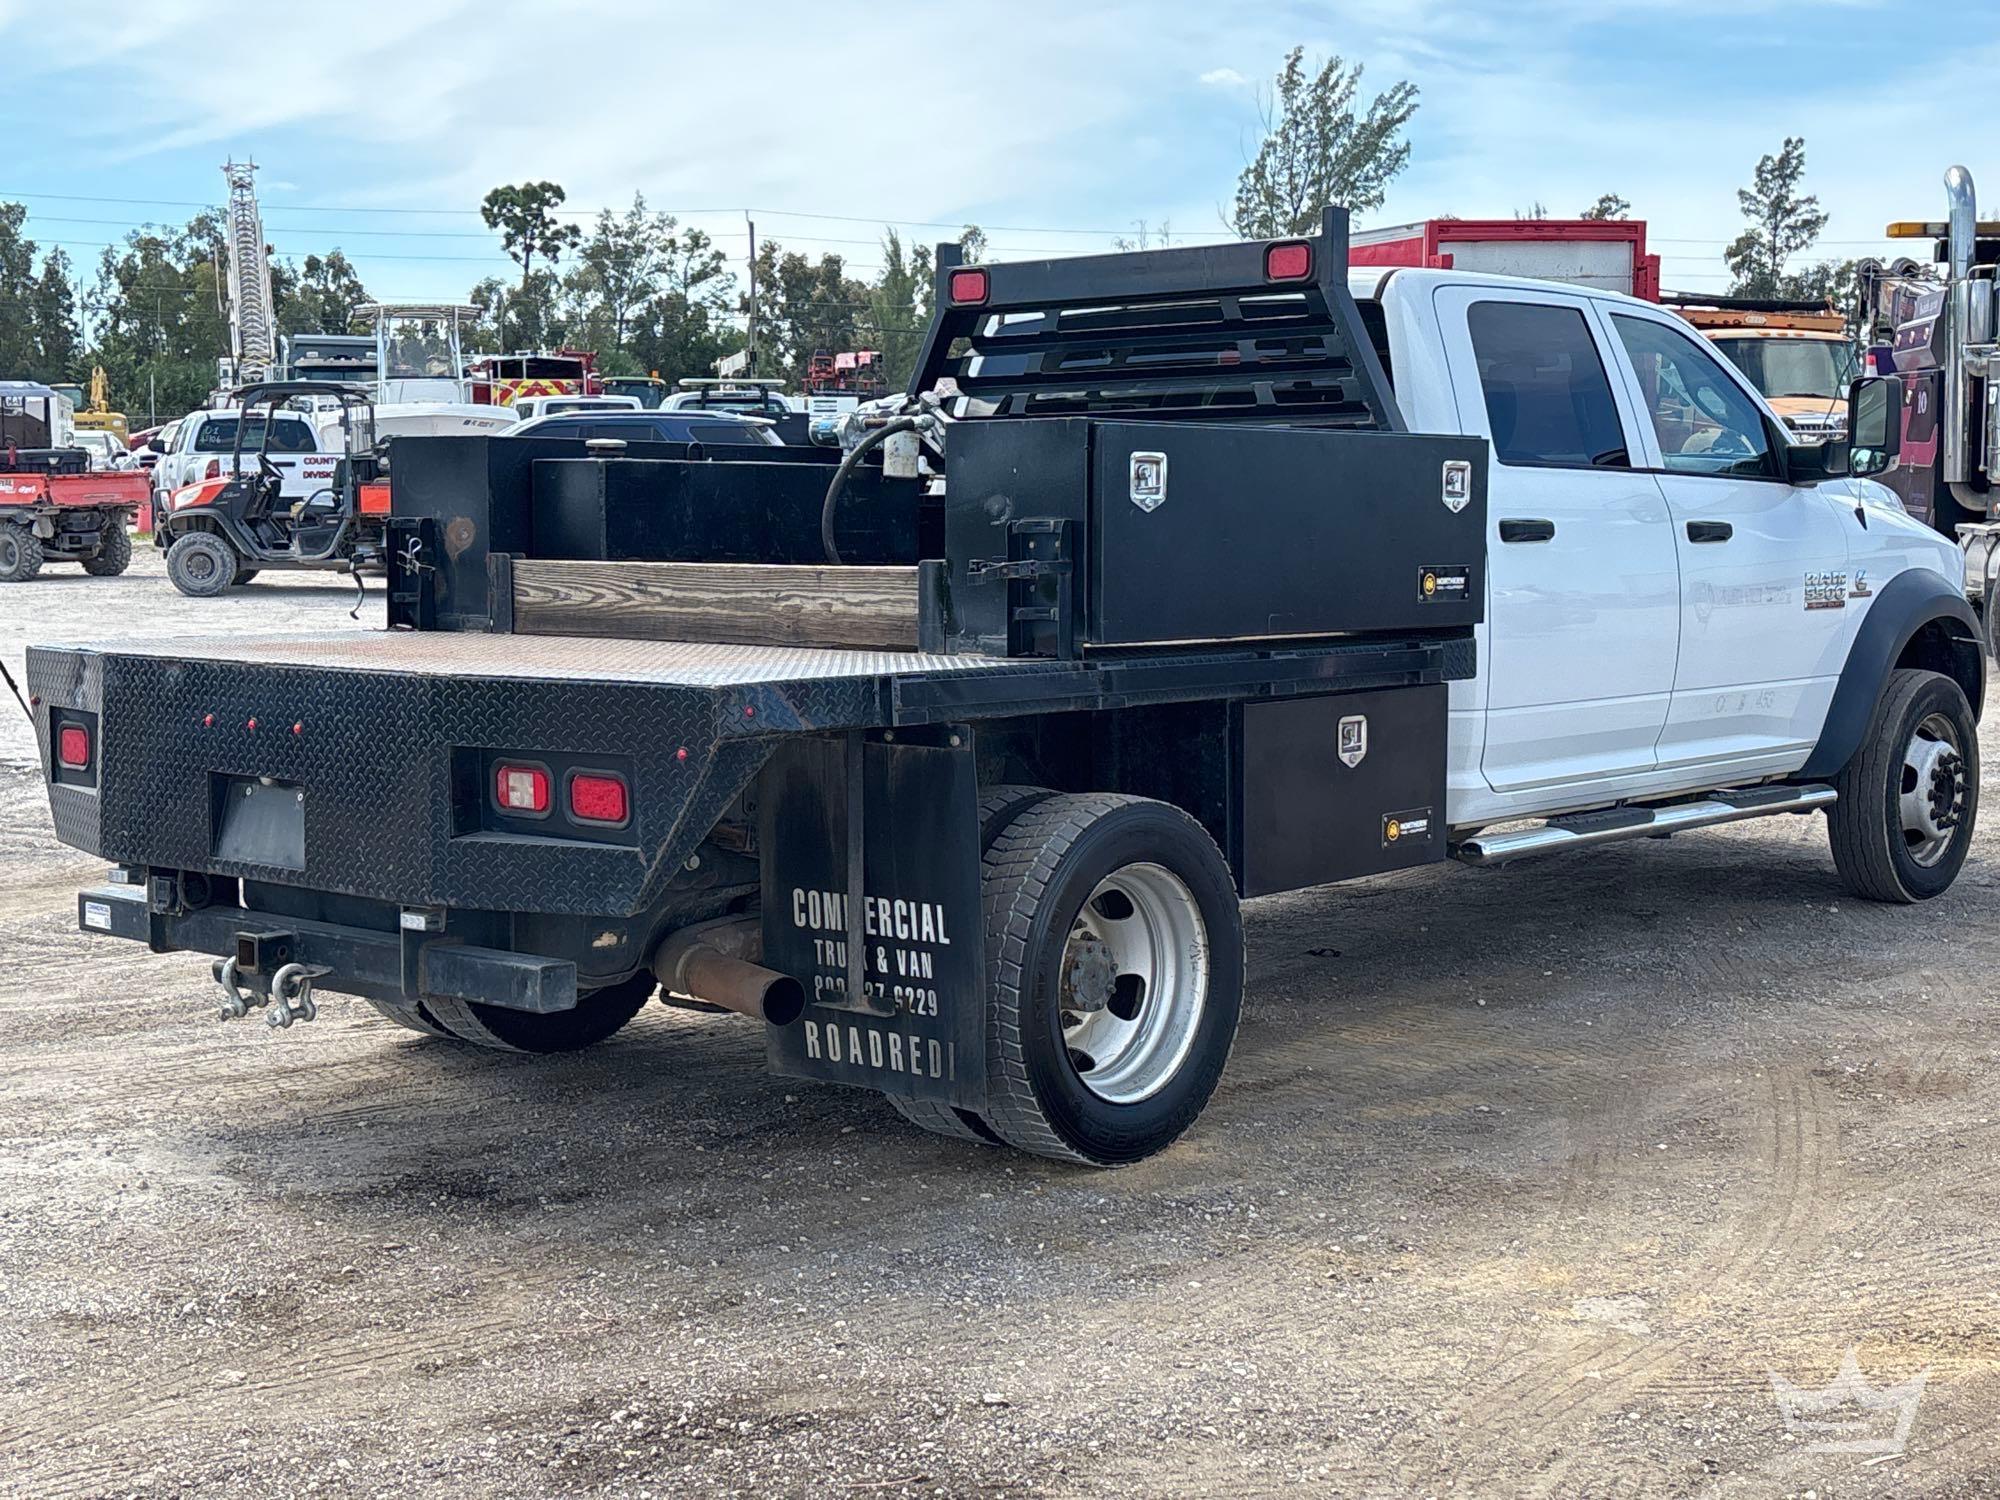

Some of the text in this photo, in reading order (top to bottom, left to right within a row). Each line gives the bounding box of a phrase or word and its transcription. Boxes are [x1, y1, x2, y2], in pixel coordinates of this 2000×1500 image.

[1918, 391, 1928, 414] 10
[303, 457, 340, 465] COUNTY
[303, 471, 335, 479] DIVISIO
[814, 939, 933, 979] TRUK & VAN
[804, 1020, 955, 1081] ROADREDI
